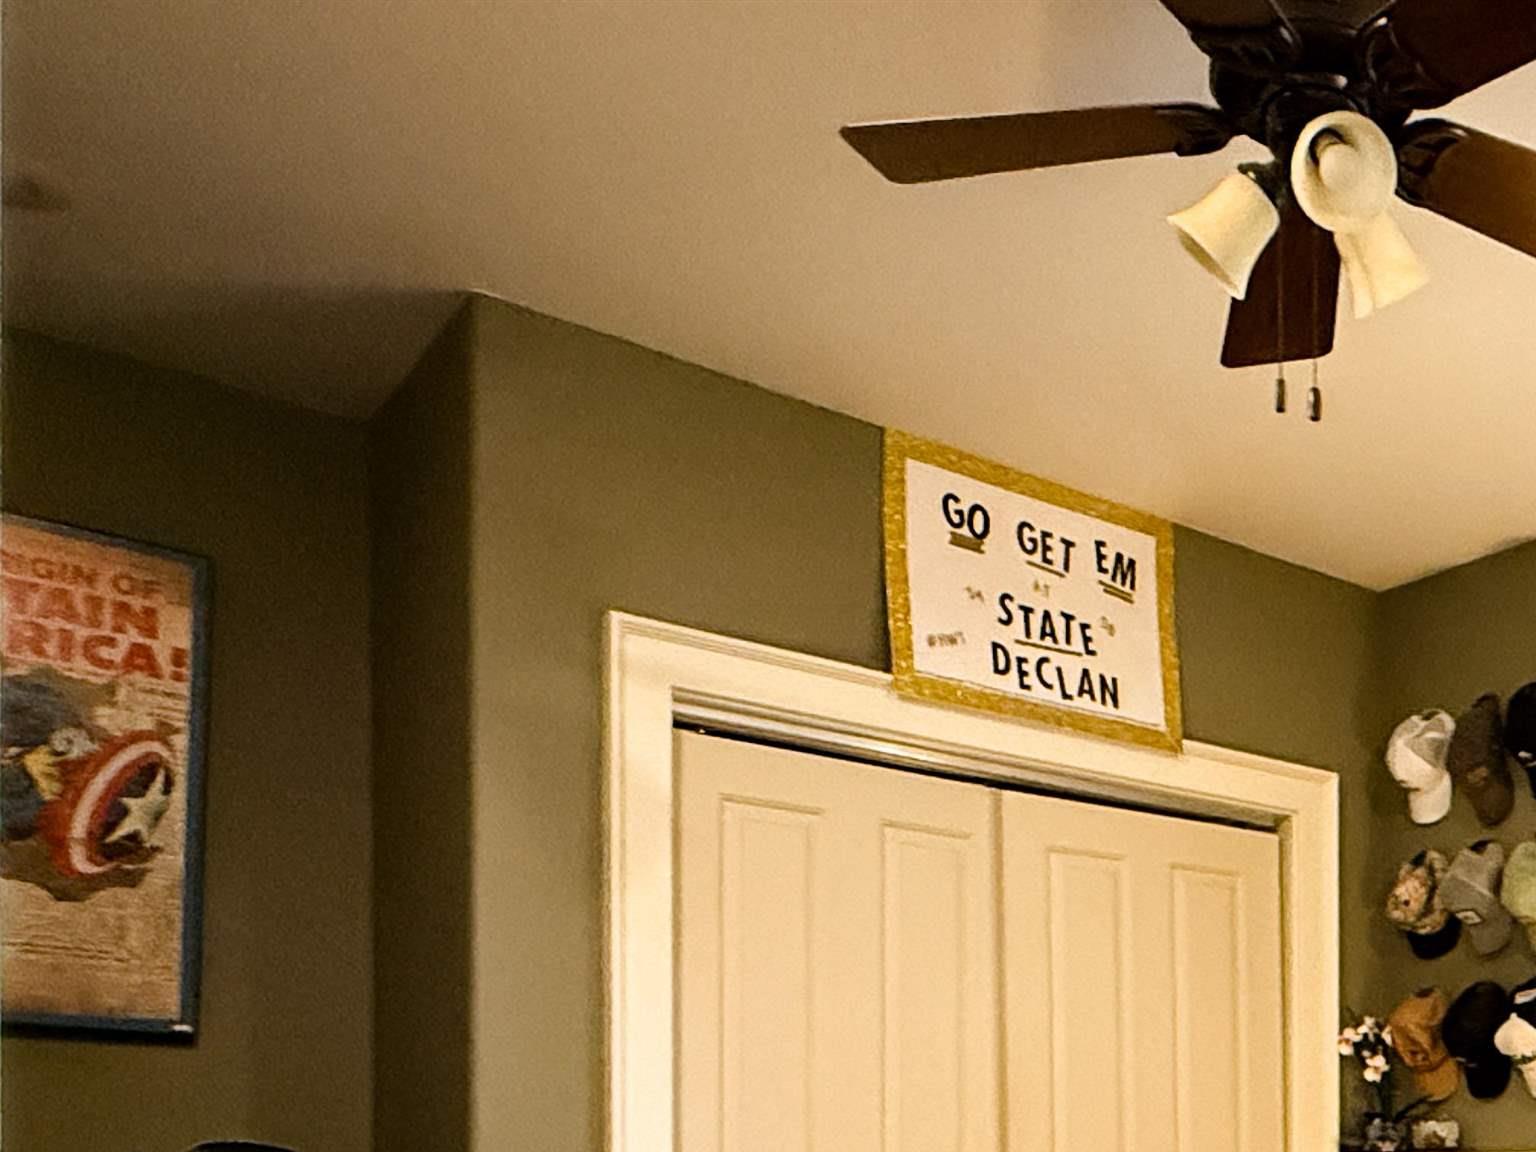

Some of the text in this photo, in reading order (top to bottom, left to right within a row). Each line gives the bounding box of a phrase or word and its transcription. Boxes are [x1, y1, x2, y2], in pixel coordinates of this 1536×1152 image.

[942, 492, 1137, 592] GO GET EM
[997, 592, 1098, 657] STATE
[991, 640, 1120, 710] DECLAN
